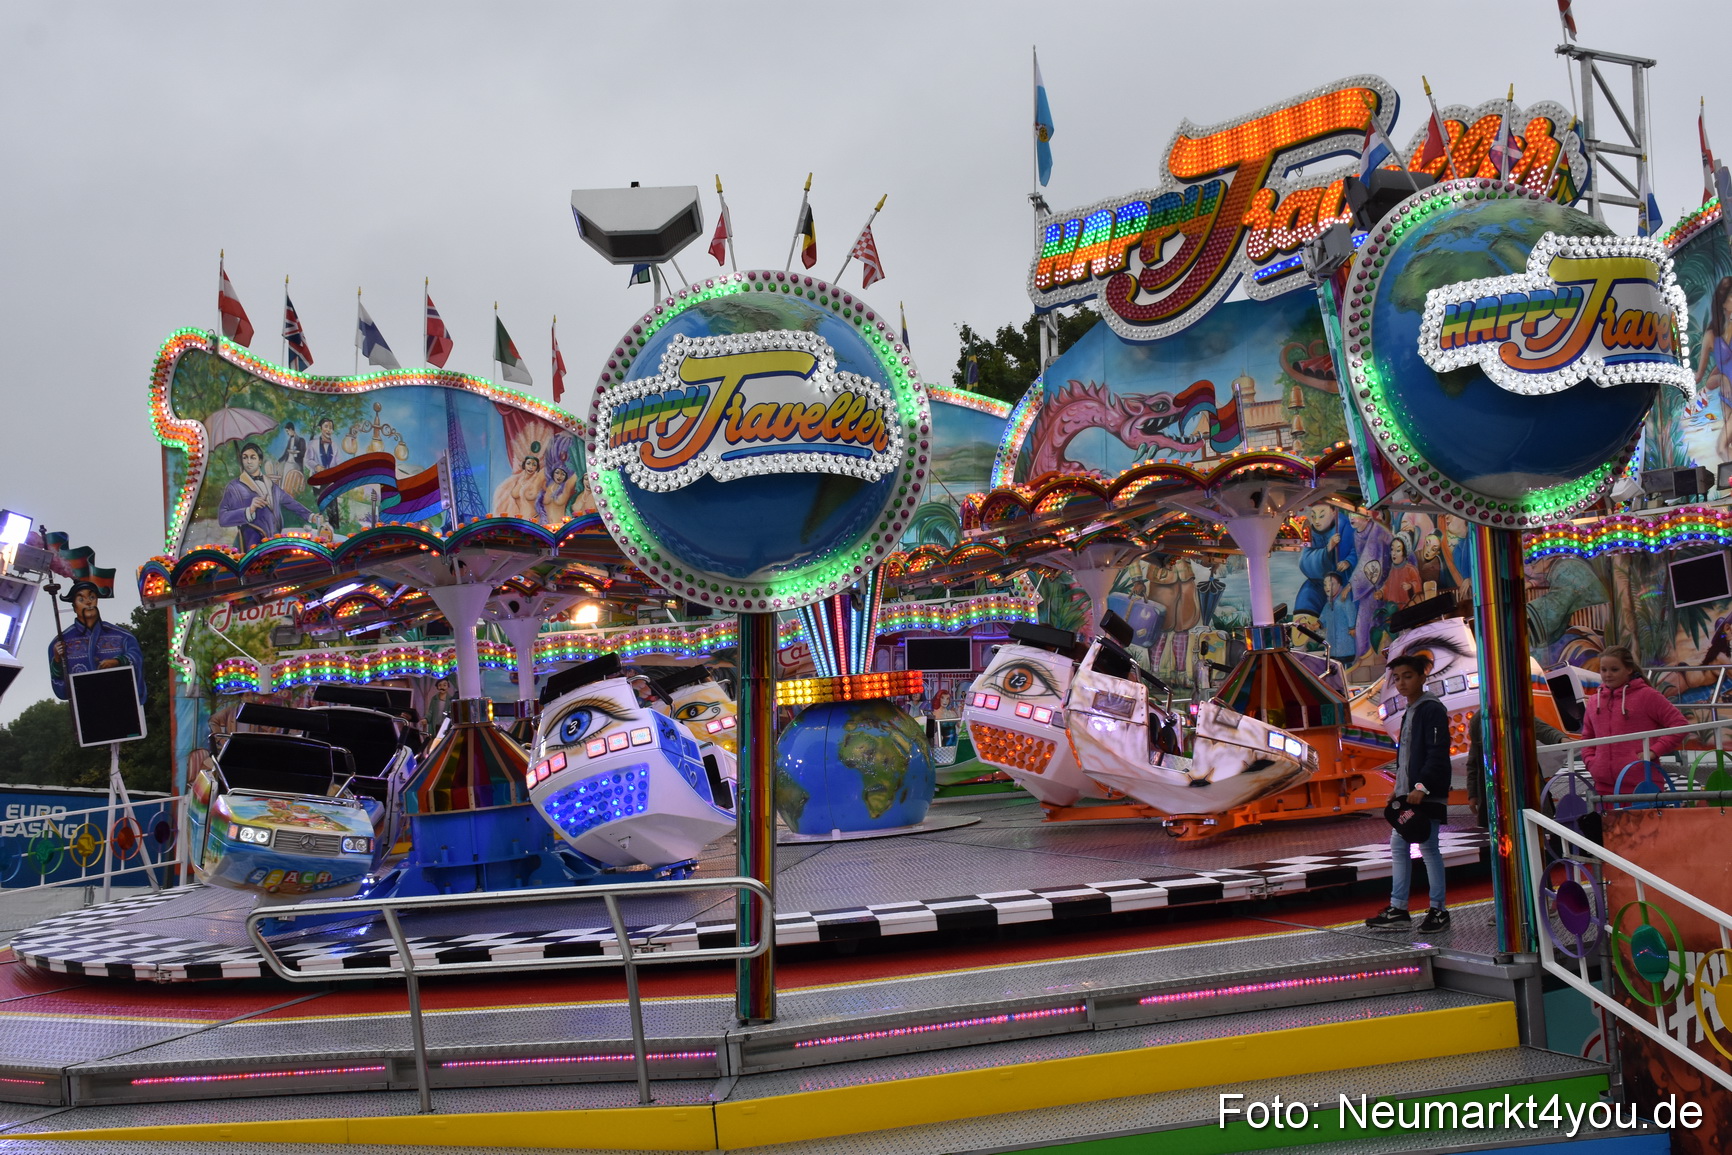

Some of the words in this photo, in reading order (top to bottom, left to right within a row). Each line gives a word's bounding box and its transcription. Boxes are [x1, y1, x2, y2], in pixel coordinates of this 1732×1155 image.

[1035, 180, 1227, 290] HAPPY
[1440, 287, 1584, 351] HAPPY
[609, 385, 709, 451] HAPPY
[640, 350, 889, 471] Traveller
[1011, 675, 1027, 686] 13
[691, 707, 698, 717] 6
[567, 720, 578, 735] 3
[6, 804, 67, 822] EURO
[0, 822, 78, 839] EASING
[252, 868, 332, 887] BEACH
